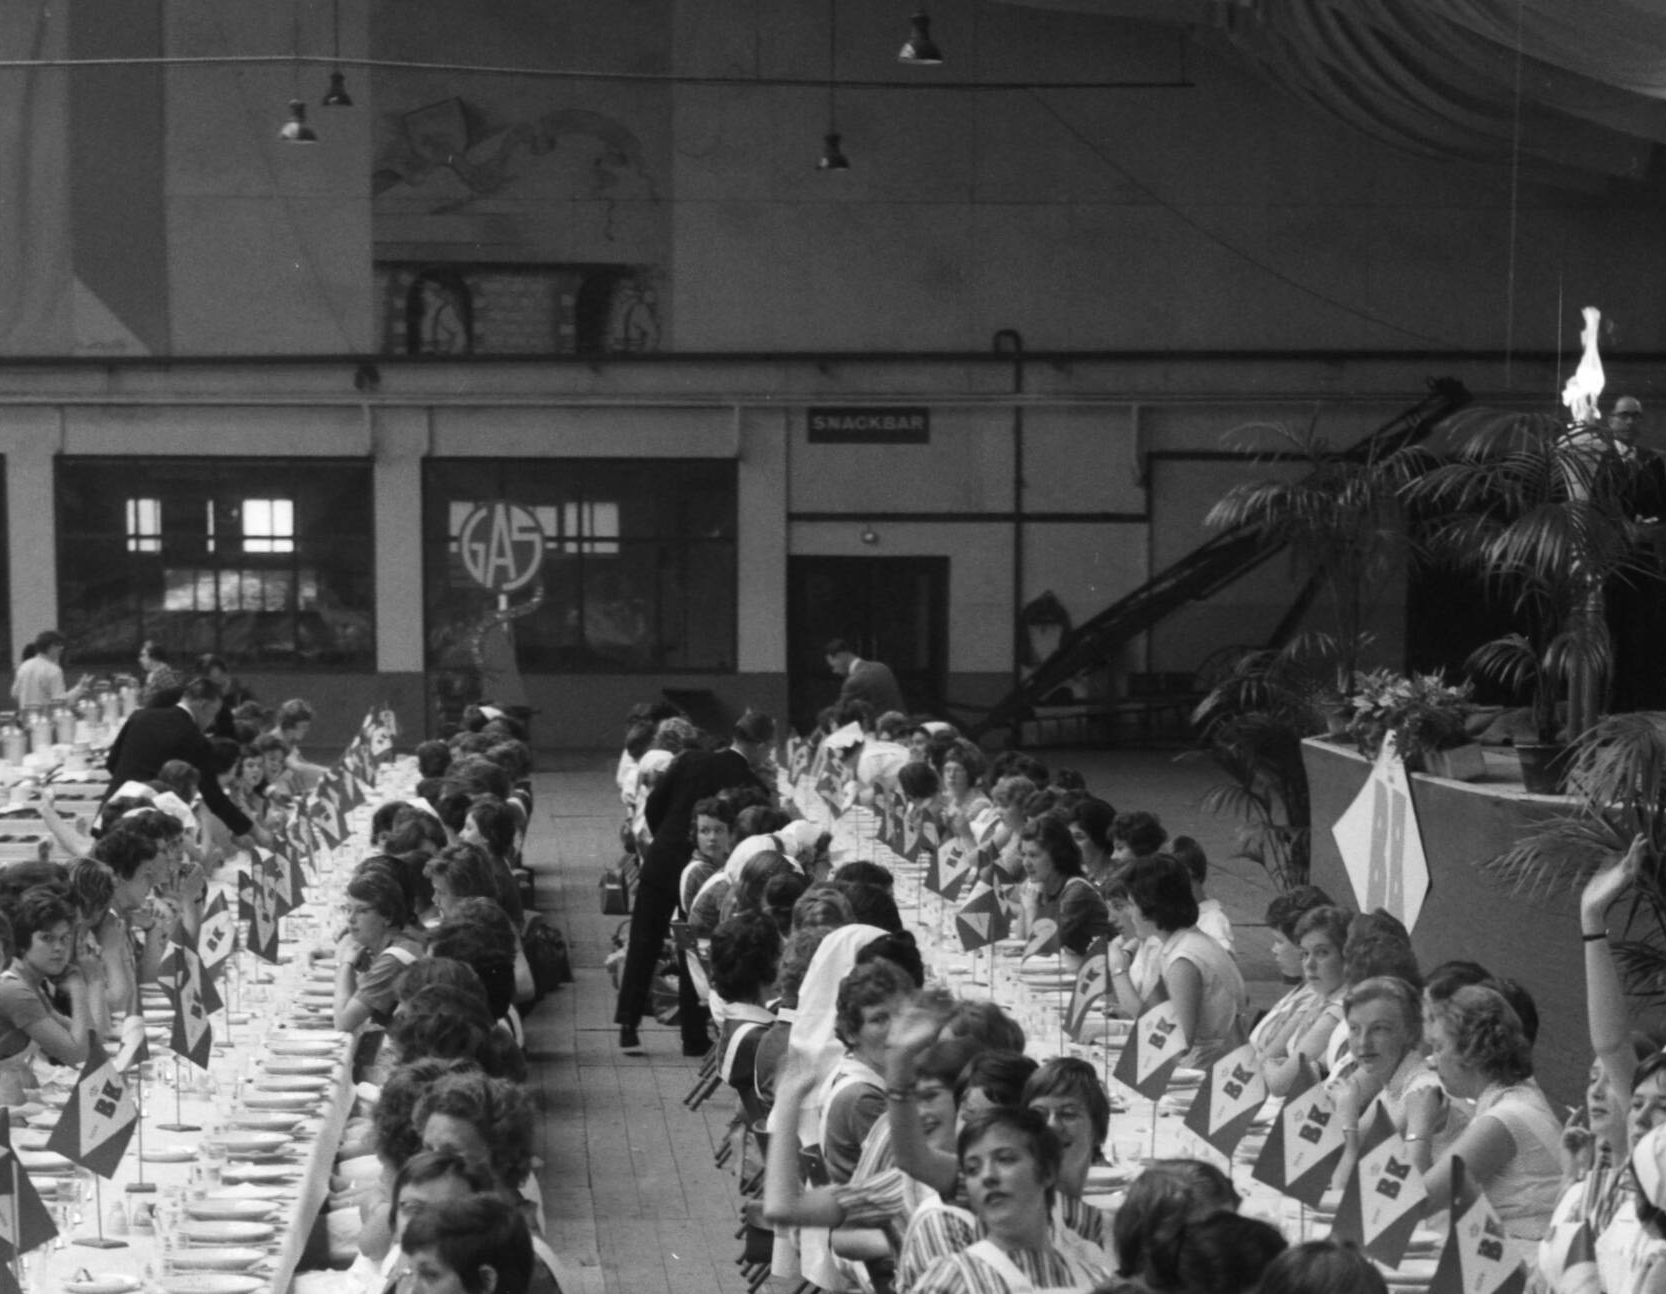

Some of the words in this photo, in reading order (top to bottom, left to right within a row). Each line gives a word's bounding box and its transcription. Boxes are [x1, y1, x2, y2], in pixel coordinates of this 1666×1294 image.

[812, 415, 925, 431] SNACKBAR
[461, 503, 543, 591] GAS
[93, 1078, 123, 1120] BK
[1222, 1062, 1255, 1101] BK
[1298, 1103, 1332, 1145] BK
[1375, 1155, 1412, 1201] BK
